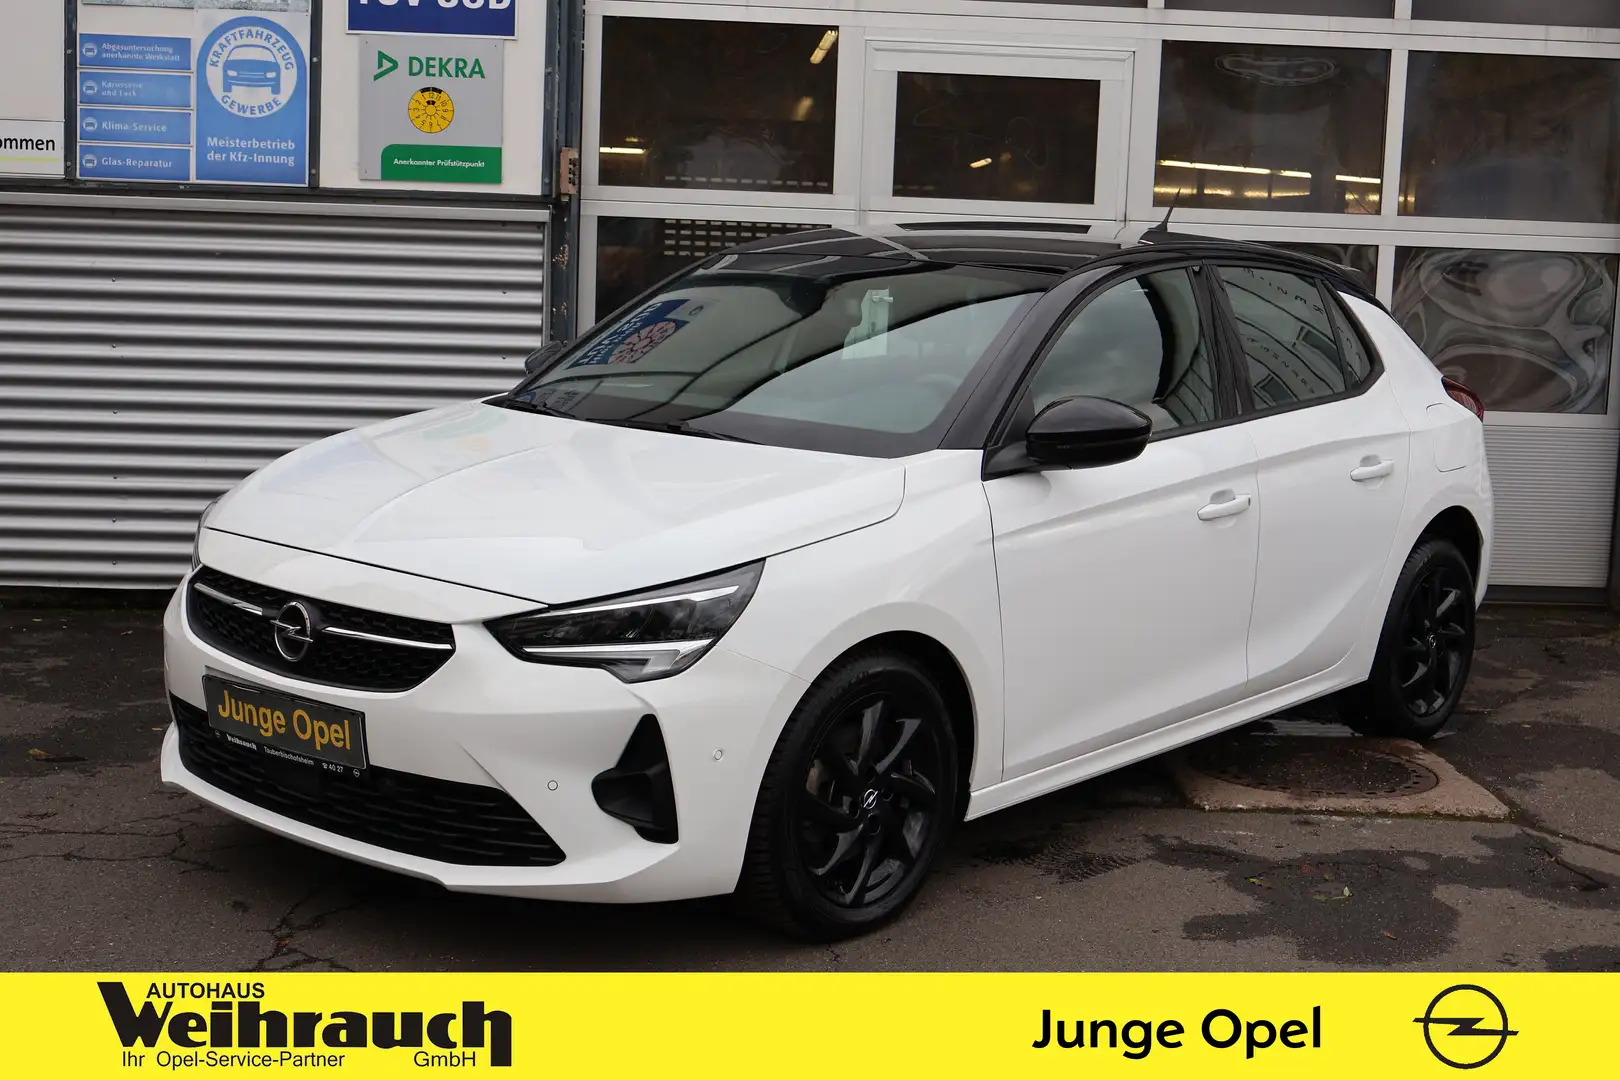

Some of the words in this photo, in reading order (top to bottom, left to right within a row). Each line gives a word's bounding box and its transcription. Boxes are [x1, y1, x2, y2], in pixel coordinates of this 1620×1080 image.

[102, 43, 173, 54] Abgasuntersuchung
[209, 28, 294, 71] KRAFTFAHRZEUG
[102, 52, 143, 60] anerkannte
[144, 53, 181, 61] Werkstatt
[408, 56, 486, 79] DEKRA
[221, 94, 283, 116] GEWERBE
[102, 122, 168, 132] Klima-Service
[0, 137, 55, 151] mmen
[207, 136, 296, 150] Meisterbetrieb
[101, 157, 173, 168] Glas-Reparatur
[207, 150, 226, 161] der
[230, 151, 295, 167] Kfz-Innung
[393, 158, 436, 166] Anerkannter
[437, 159, 485, 168] Prüfstützpunkt
[218, 690, 286, 737] Junge
[292, 709, 350, 750] Opel
[263, 746, 315, 765] Tauberbischofsheim
[336, 765, 344, 773] 27
